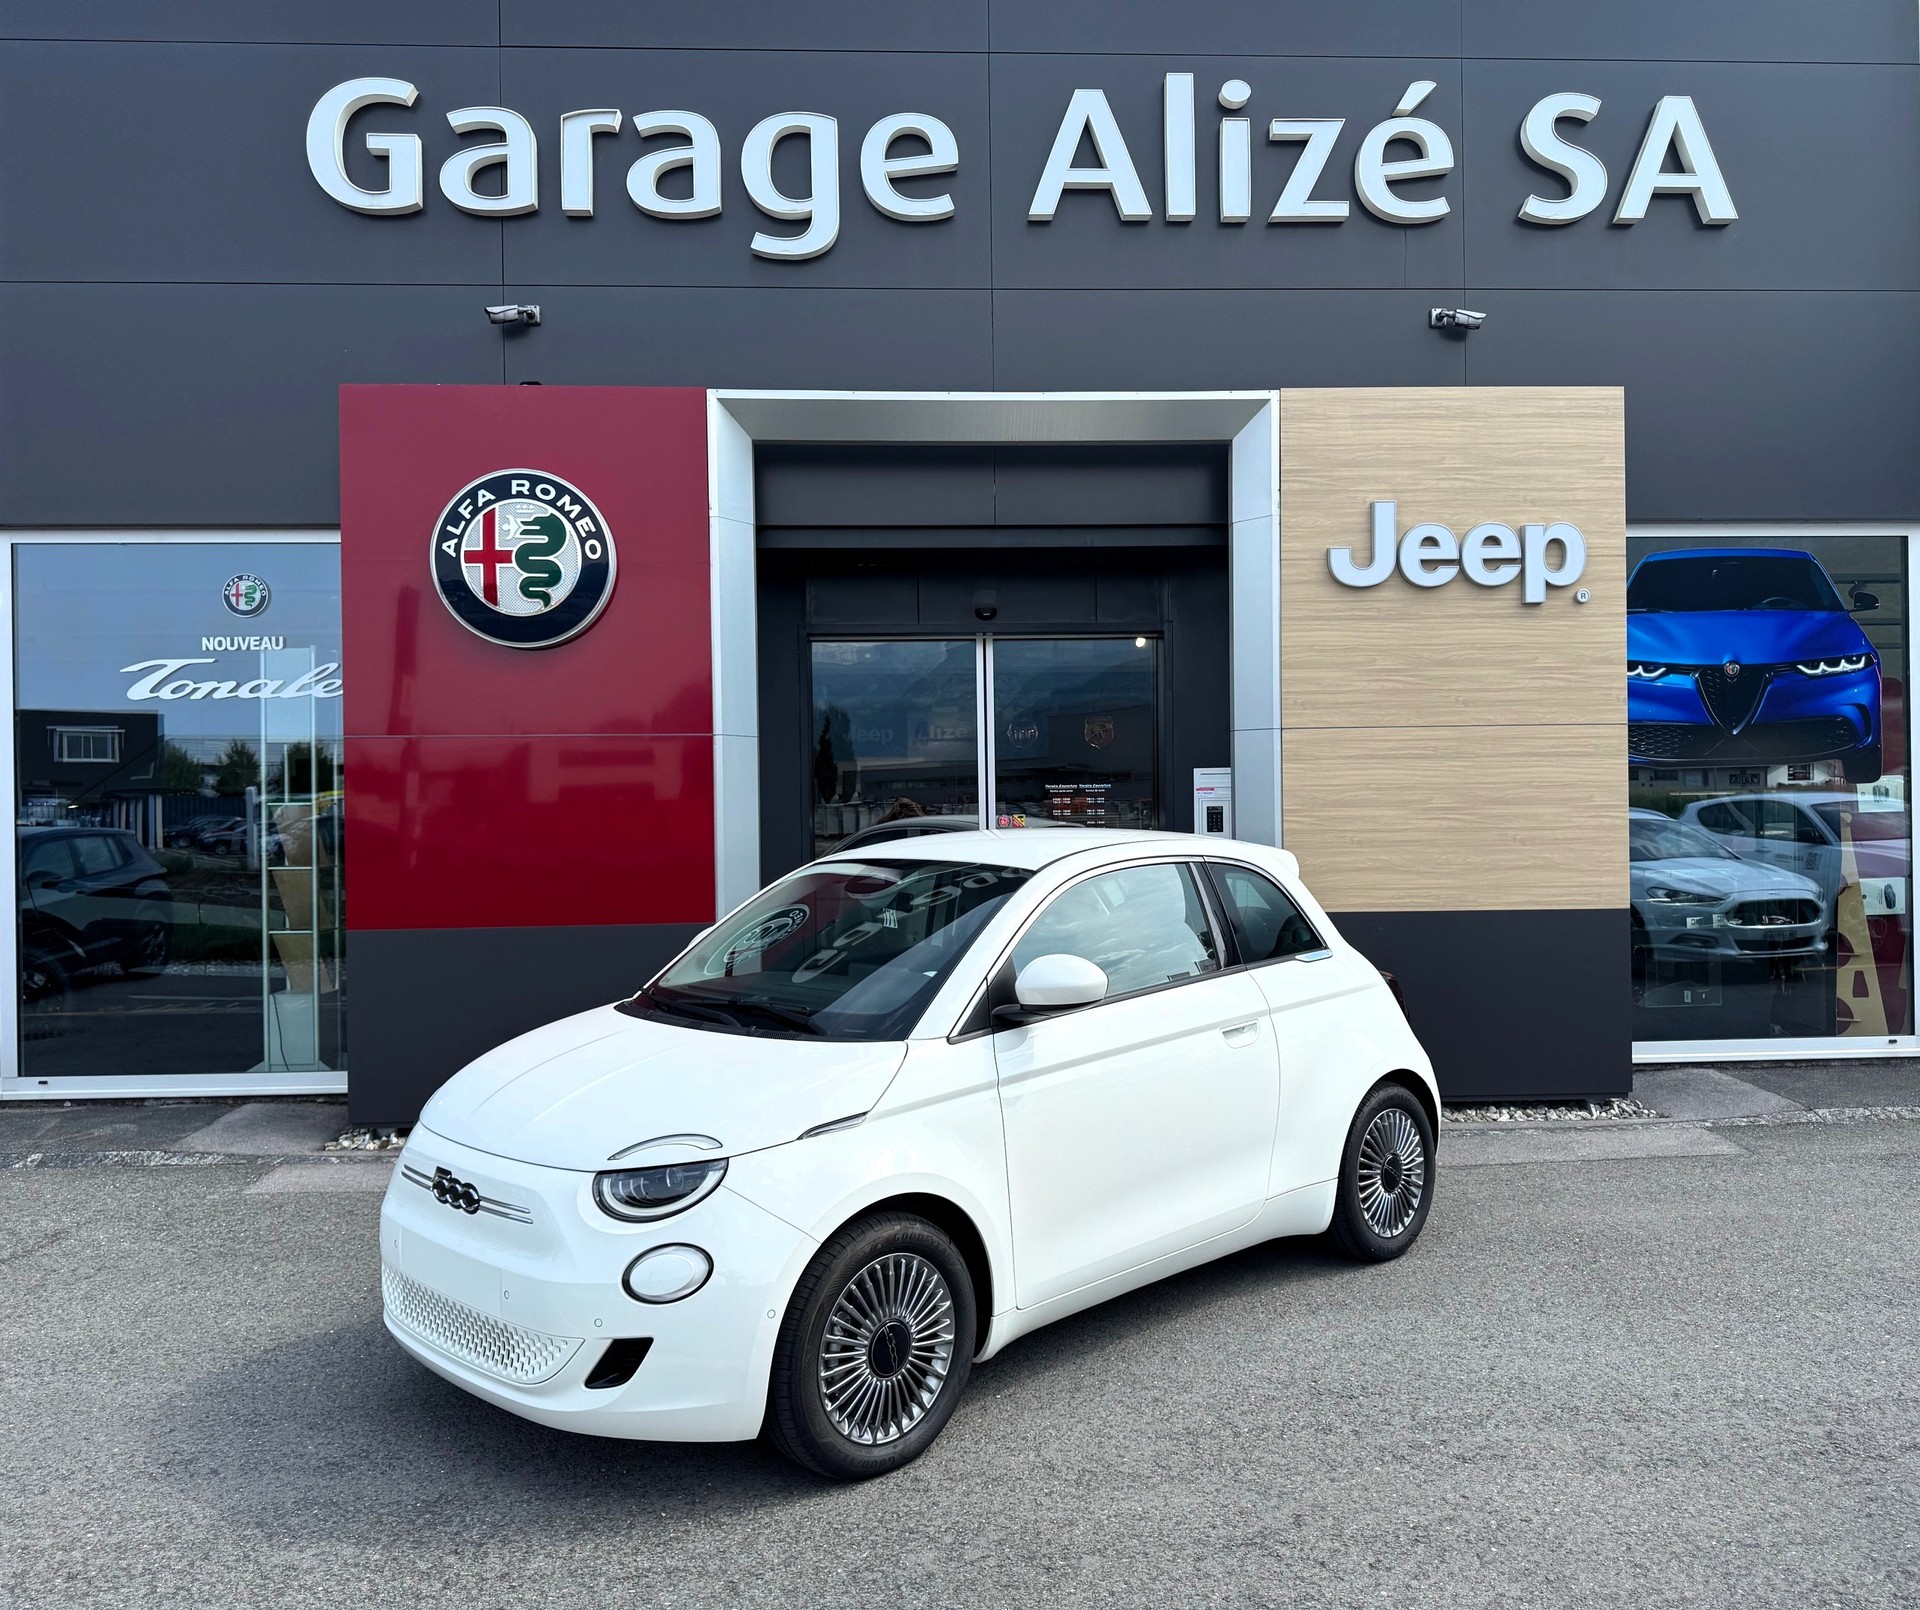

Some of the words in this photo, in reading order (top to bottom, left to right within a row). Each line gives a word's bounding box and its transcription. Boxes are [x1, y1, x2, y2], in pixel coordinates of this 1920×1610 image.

[306, 77, 959, 260] Garage
[1027, 72, 1455, 224] Alizé
[1518, 92, 1739, 226] SA
[441, 488, 496, 558] ALFA
[510, 479, 602, 560] ROMEO
[1328, 499, 1588, 605] Jeep
[224, 577, 240, 596] ALFA
[242, 575, 266, 597] ROMEO
[201, 636, 285, 651] NOUVEAU
[119, 658, 344, 701] Tonale
[431, 1165, 481, 1216] 500
